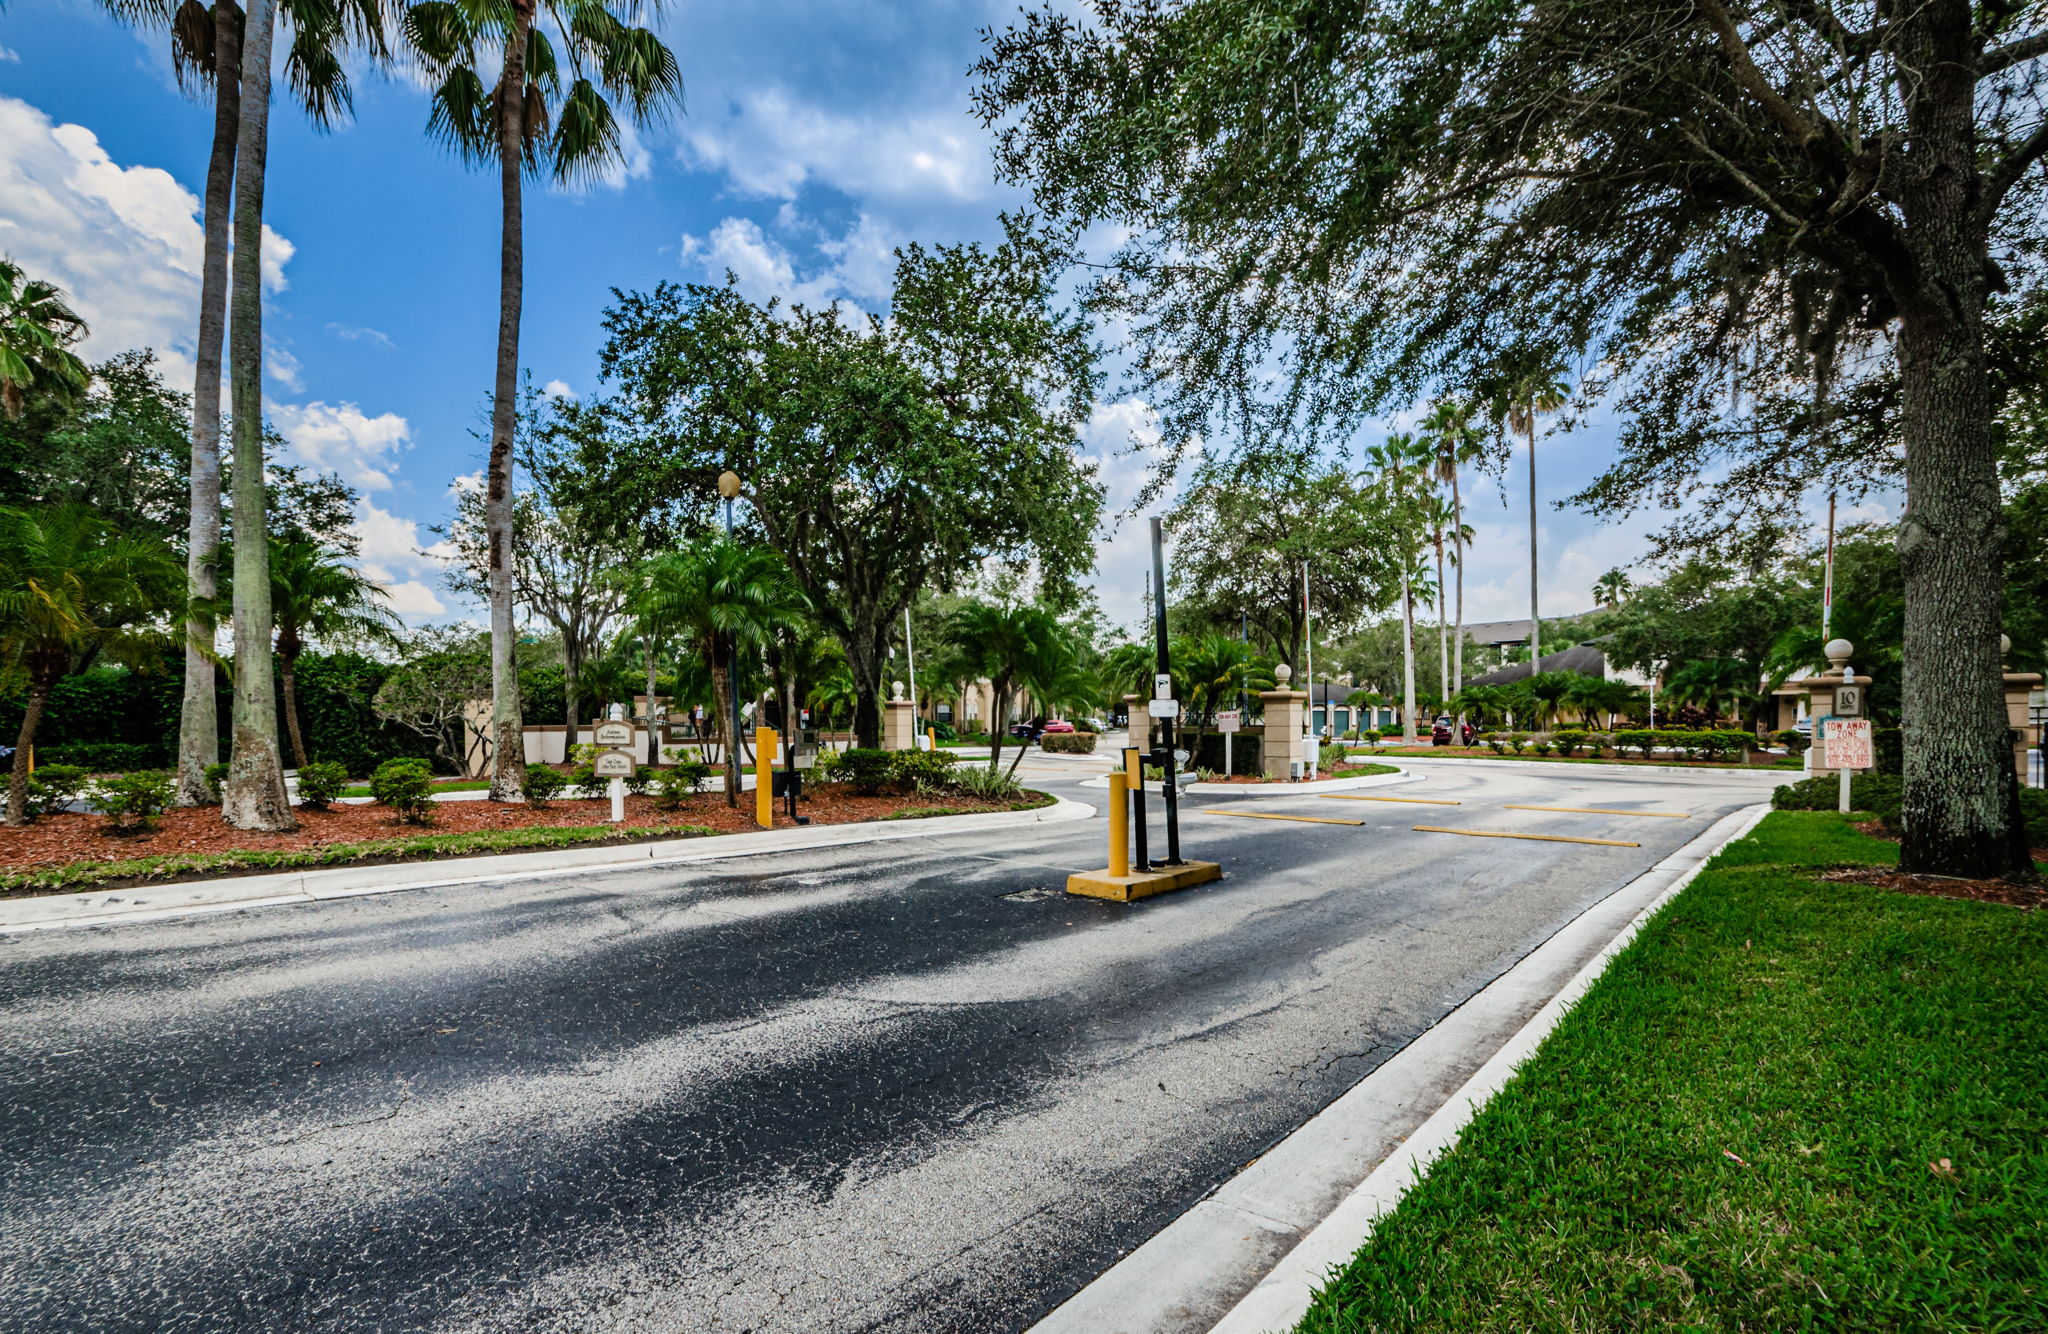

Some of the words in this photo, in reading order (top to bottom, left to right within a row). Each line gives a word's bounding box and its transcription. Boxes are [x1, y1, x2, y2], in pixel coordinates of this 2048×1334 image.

[1840, 691, 1855, 704] 10
[1827, 722, 1842, 731] TOW
[1847, 721, 1867, 730] AWAY
[1837, 730, 1857, 739] ZONE
